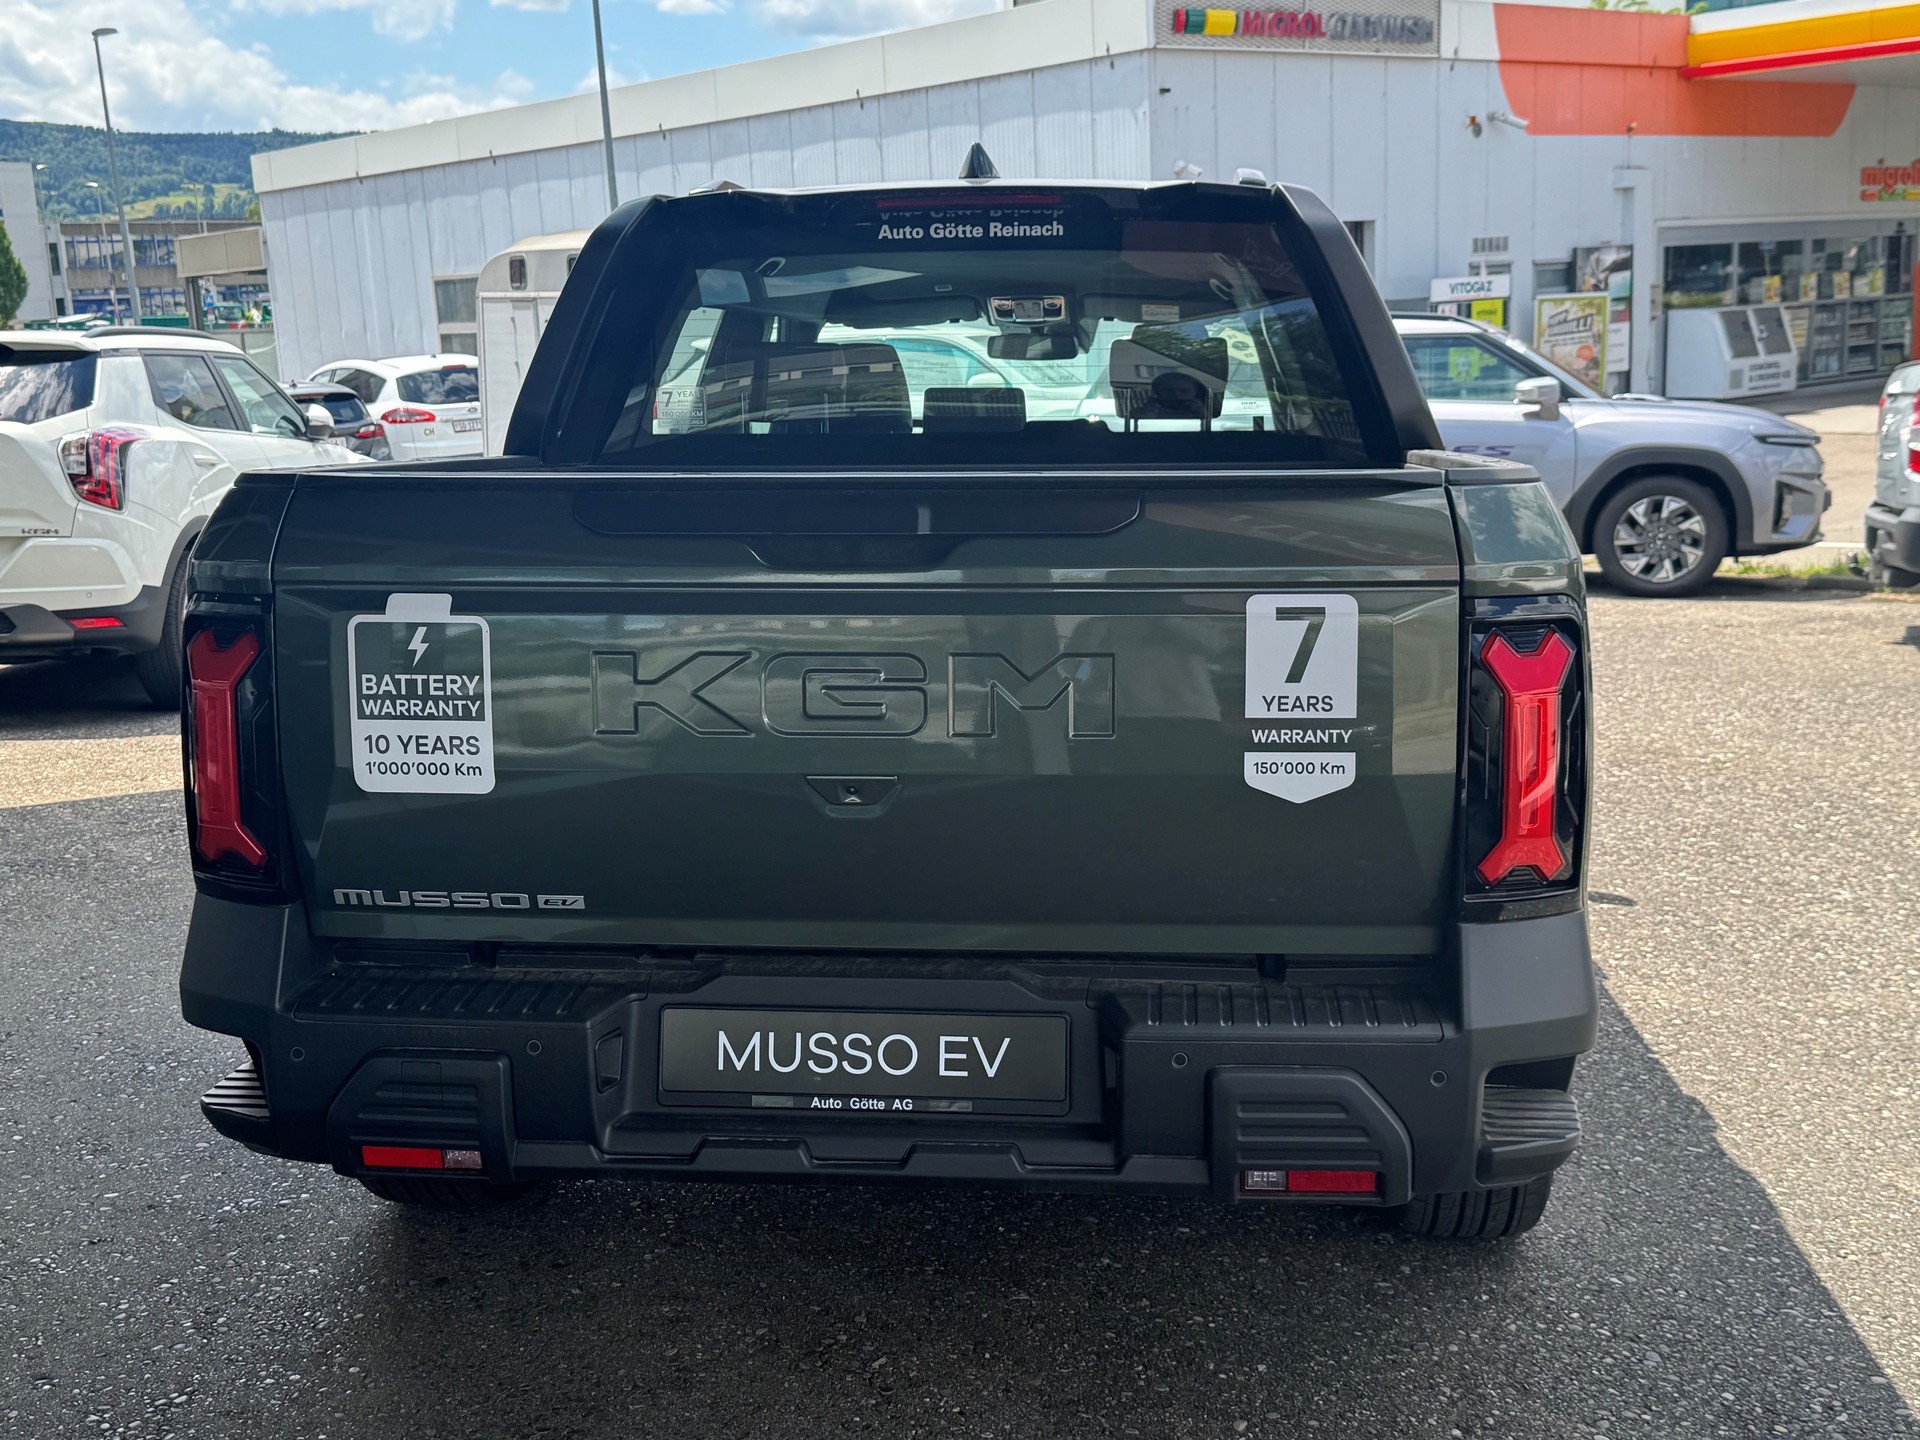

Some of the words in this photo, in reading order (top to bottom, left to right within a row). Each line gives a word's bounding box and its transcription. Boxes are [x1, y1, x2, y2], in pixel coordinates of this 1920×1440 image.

[1241, 10, 1327, 38] MIGROL
[878, 225, 924, 239] Auto
[929, 222, 984, 238] Götte
[989, 221, 1064, 238] Reinach
[1449, 281, 1493, 294] VITOGAZ
[1275, 606, 1326, 683] 7
[361, 674, 480, 696] BATTERY
[589, 649, 1119, 739] KGM
[362, 698, 482, 718] WARRANTY
[1262, 695, 1334, 713] YEARS
[364, 734, 390, 755] 10
[396, 735, 481, 756] YEARS
[1251, 729, 1353, 744] WARRANTY
[365, 760, 450, 777] 1'000'000
[454, 762, 483, 777] Km
[1253, 760, 1315, 775] 150'000
[1320, 761, 1346, 776] Km
[333, 888, 530, 910] MUSSO
[542, 897, 581, 908] EV
[717, 1030, 919, 1077] MUSSO
[938, 1035, 1012, 1078] EV
[811, 1096, 843, 1110] Auto
[849, 1097, 886, 1110] Götte
[892, 1098, 913, 1111] AG
